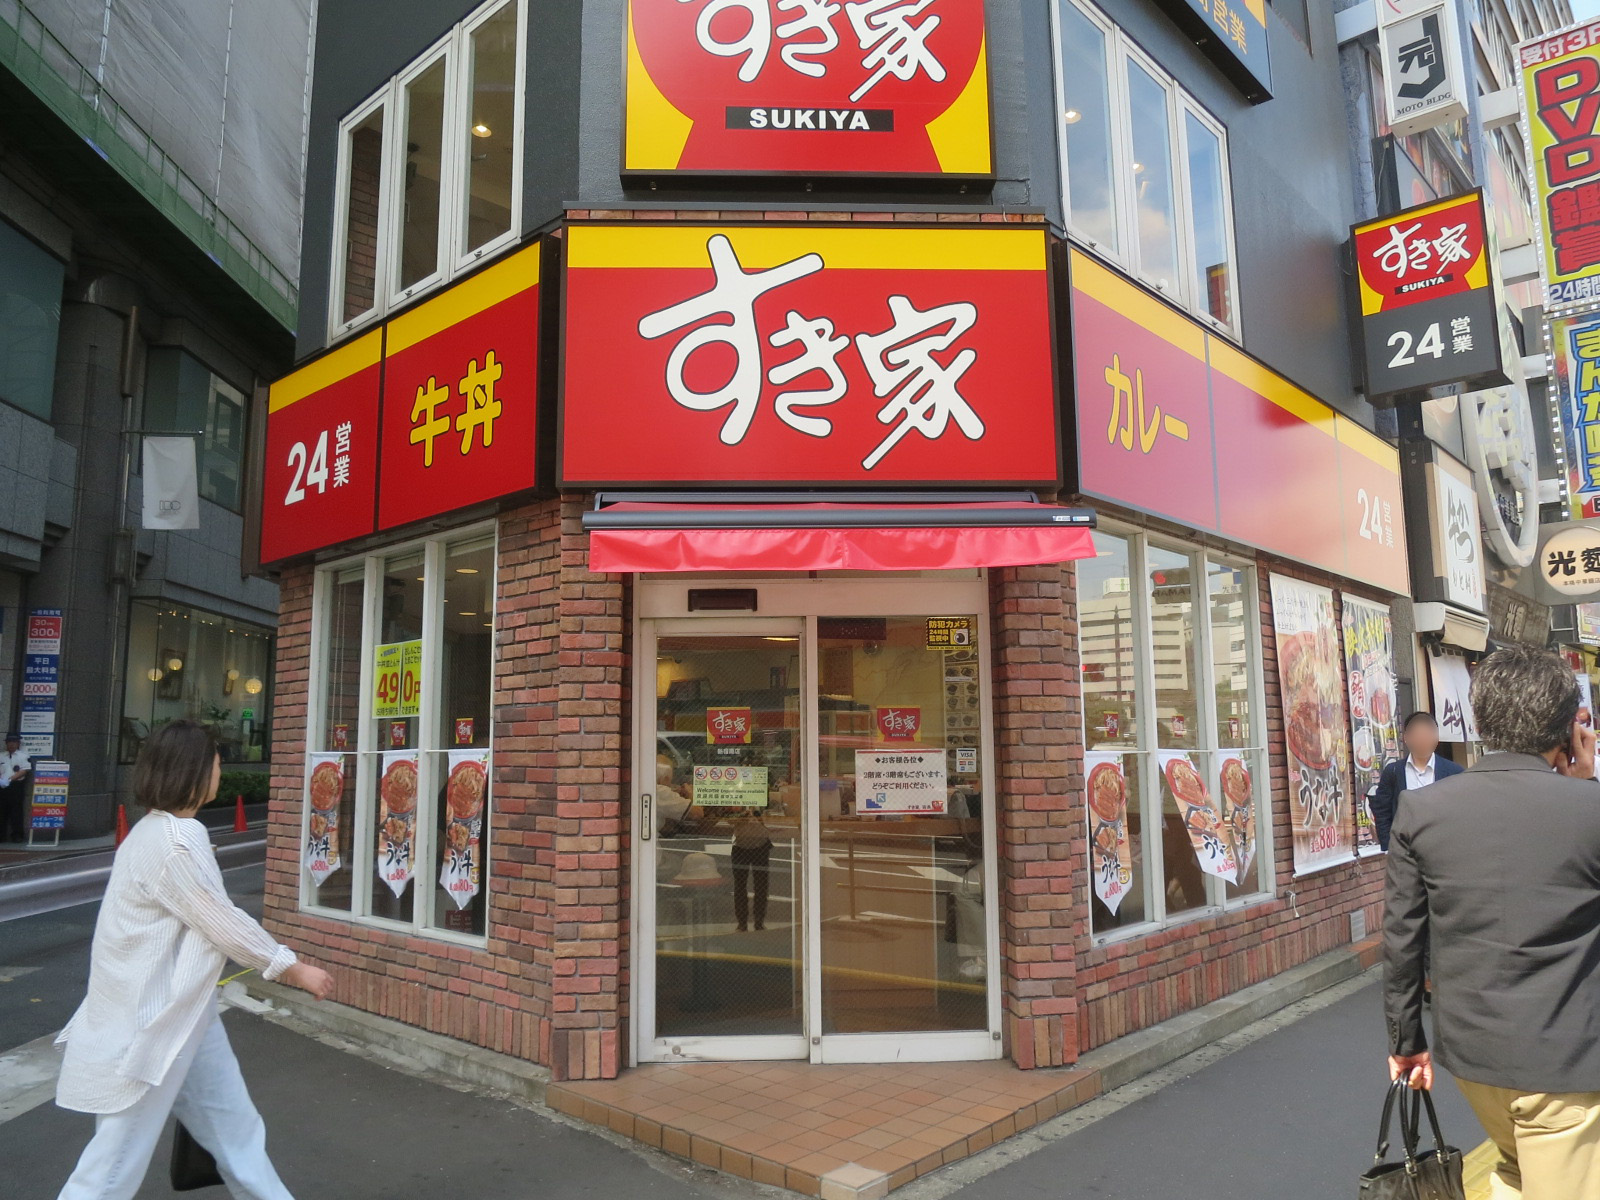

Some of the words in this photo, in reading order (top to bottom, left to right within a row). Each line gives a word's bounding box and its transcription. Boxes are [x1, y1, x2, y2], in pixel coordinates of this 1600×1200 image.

[1397, 101, 1424, 115] MOTO
[1426, 91, 1452, 105] BLDG
[749, 108, 871, 131] SUKIYA
[1372, 223, 1471, 278] すき家
[1401, 275, 1445, 293] SUKIYA
[638, 234, 985, 471] すき家
[409, 349, 503, 467] 牛丼
[1104, 353, 1189, 454] カレー
[712, 711, 746, 734] すき家
[883, 709, 916, 732] すき家
